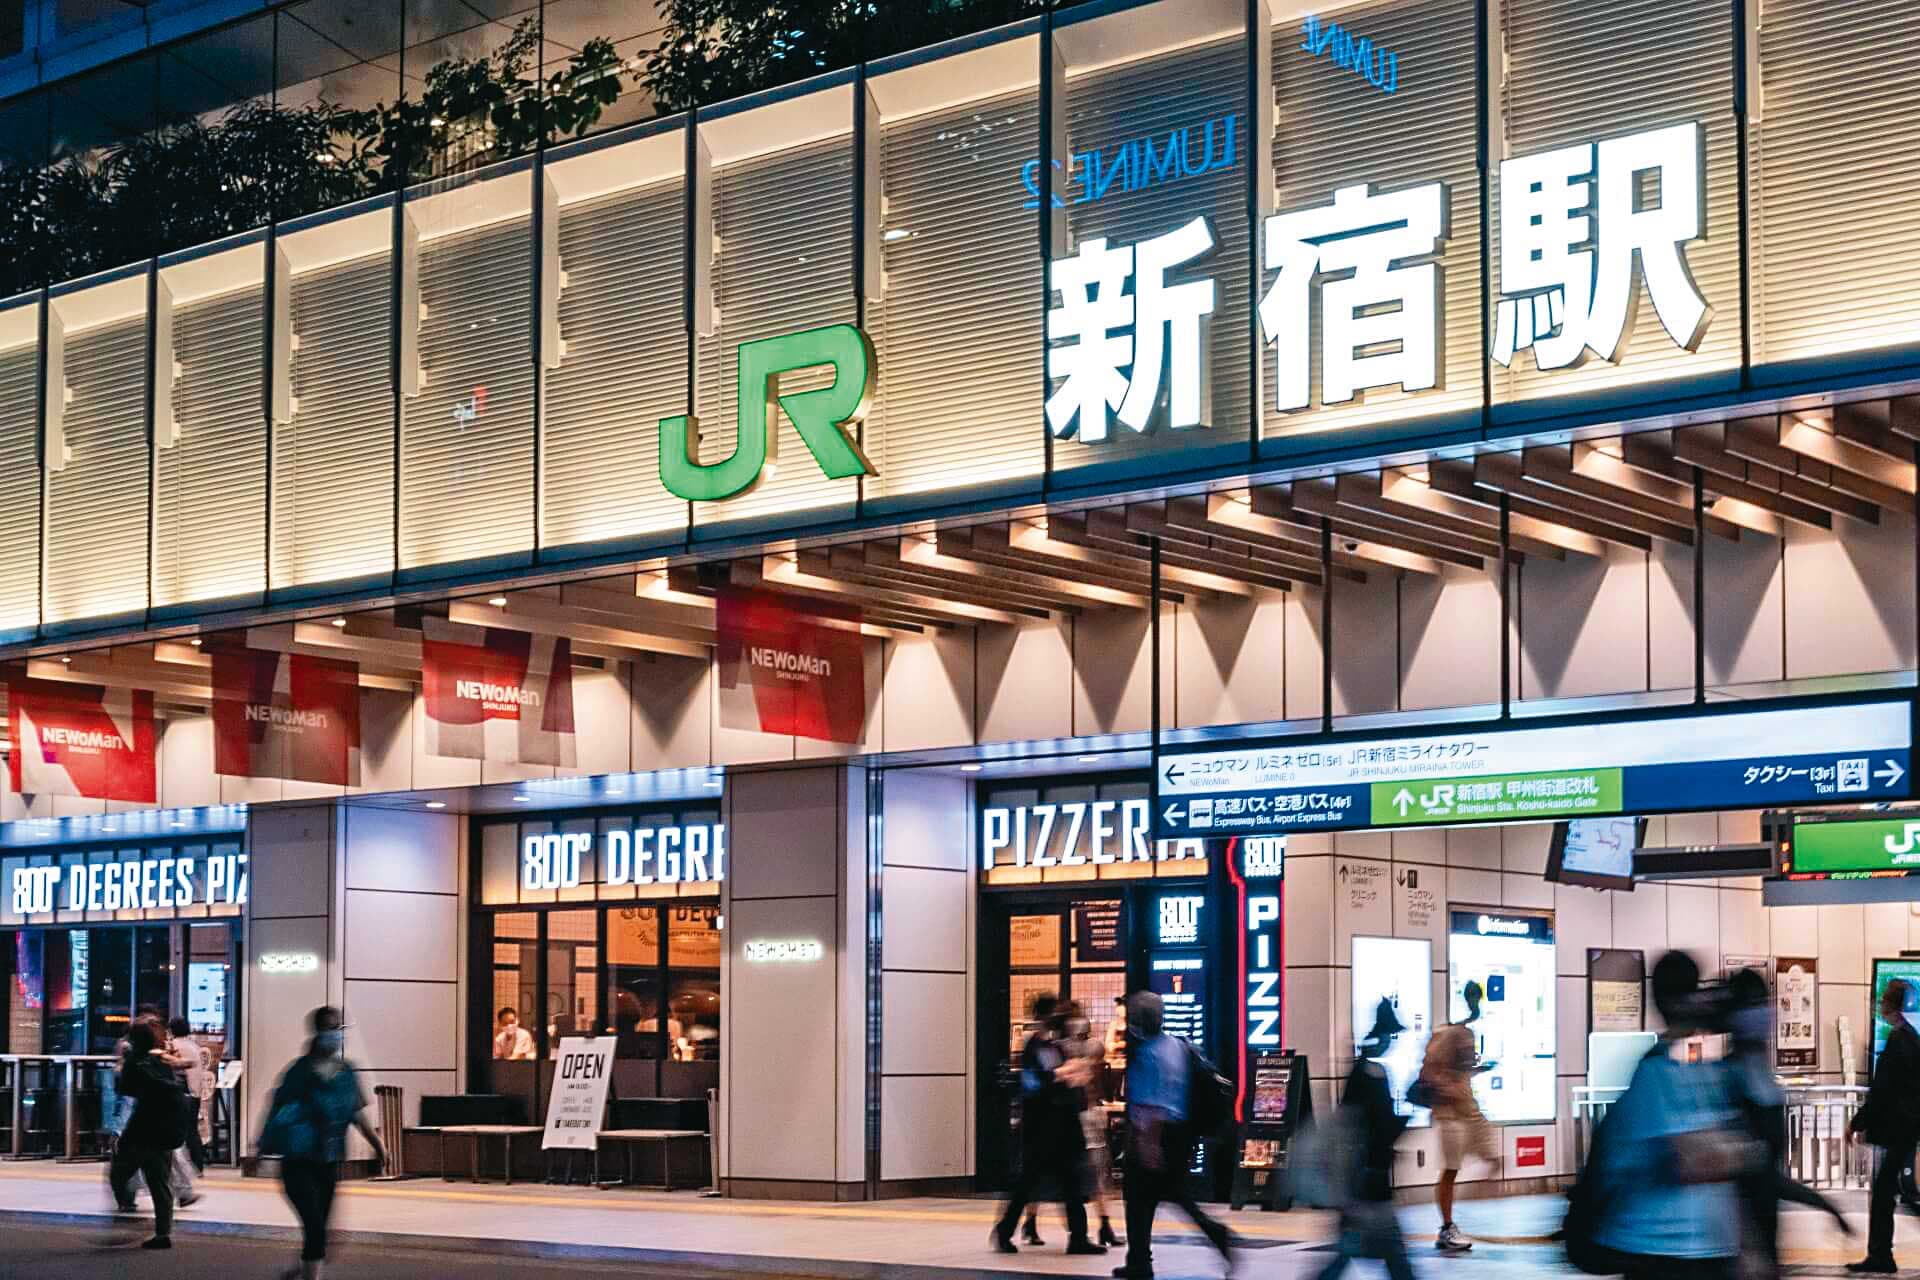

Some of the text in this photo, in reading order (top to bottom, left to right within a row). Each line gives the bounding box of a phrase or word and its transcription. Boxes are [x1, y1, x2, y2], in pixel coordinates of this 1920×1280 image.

[659, 122, 1708, 500] JR 新宿駅
[751, 647, 831, 676] NEWoMan
[456, 680, 539, 706] NEWoMan
[42, 727, 122, 749] NEWoMan
[1190, 758, 1249, 774] ニュウマン
[1420, 784, 1456, 808] JR
[1814, 783, 1834, 794] Taxi
[1214, 814, 1256, 829] Expressway
[1273, 812, 1297, 825] Airport
[1298, 809, 1326, 823] Express
[1327, 809, 1343, 822] Bus
[70, 857, 195, 912] DEGREES
[561, 1053, 605, 1079] OPEN
